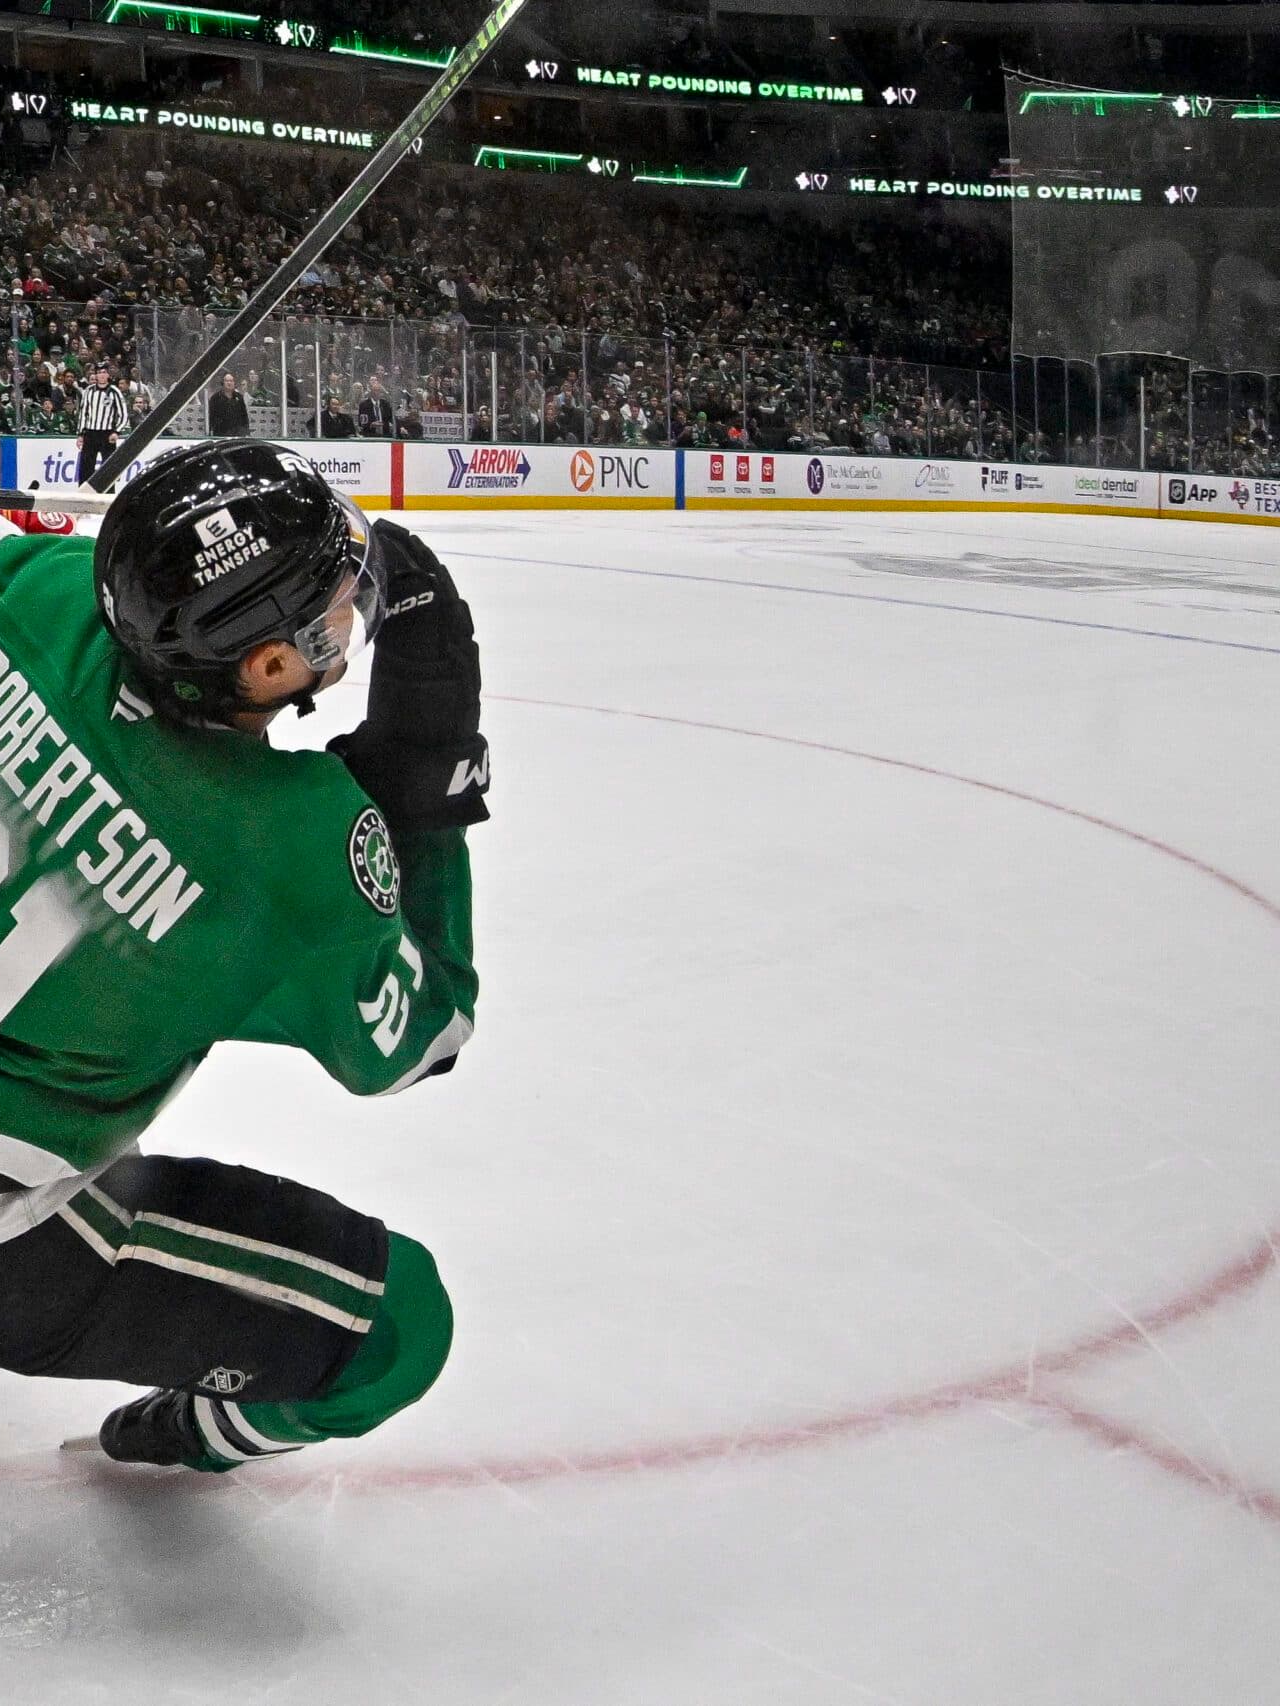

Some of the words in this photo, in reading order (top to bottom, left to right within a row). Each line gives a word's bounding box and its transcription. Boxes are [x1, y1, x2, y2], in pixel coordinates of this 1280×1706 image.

[577, 67, 641, 87] HEART
[649, 74, 752, 95] POUNDING
[758, 83, 864, 101] OVERTIME
[71, 101, 149, 123] HEART
[158, 110, 265, 136] POUNDING
[272, 122, 373, 148] OVERTIME
[849, 177, 919, 195] HEART
[927, 182, 1030, 199] POUNDING
[1037, 186, 1143, 203] OVERTIME
[467, 449, 520, 474] ARROW
[600, 456, 649, 488] PNC
[465, 476, 519, 488] EXTERMINATORS
[1075, 474, 1100, 491] ideal
[1102, 477, 1138, 493] dental
[193, 537, 271, 586] TRANSFER
[194, 525, 255, 569] ENERGY
